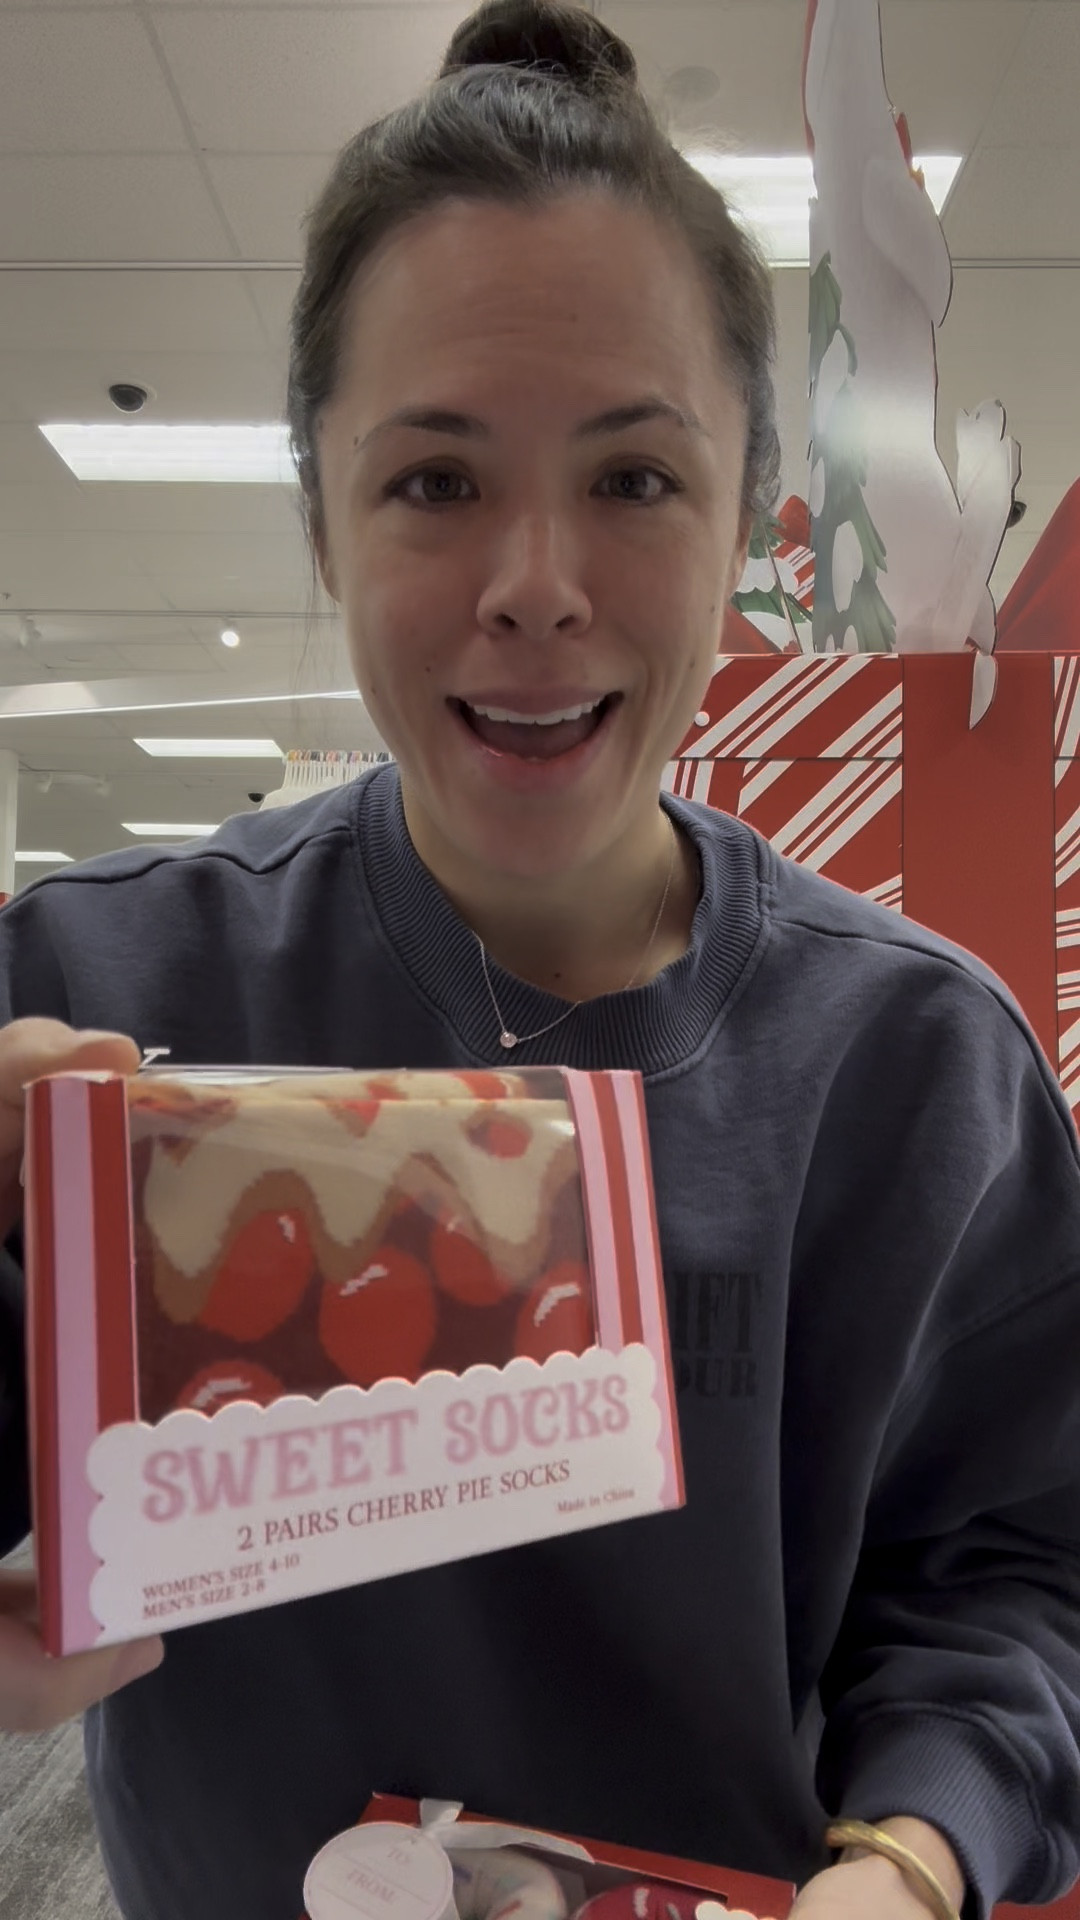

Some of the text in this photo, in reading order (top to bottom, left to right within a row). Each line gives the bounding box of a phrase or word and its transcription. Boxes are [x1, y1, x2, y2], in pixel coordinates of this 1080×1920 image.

[142, 1374, 631, 1523] SWEET SOCKS
[237, 1459, 571, 1551] 2 PAIRS CHERRY PIE SOCKS
[142, 1553, 300, 1600] WOMEN'S SIZE 4-10
[142, 1594, 195, 1619] MEN'S
[200, 1586, 234, 1606] SIZE
